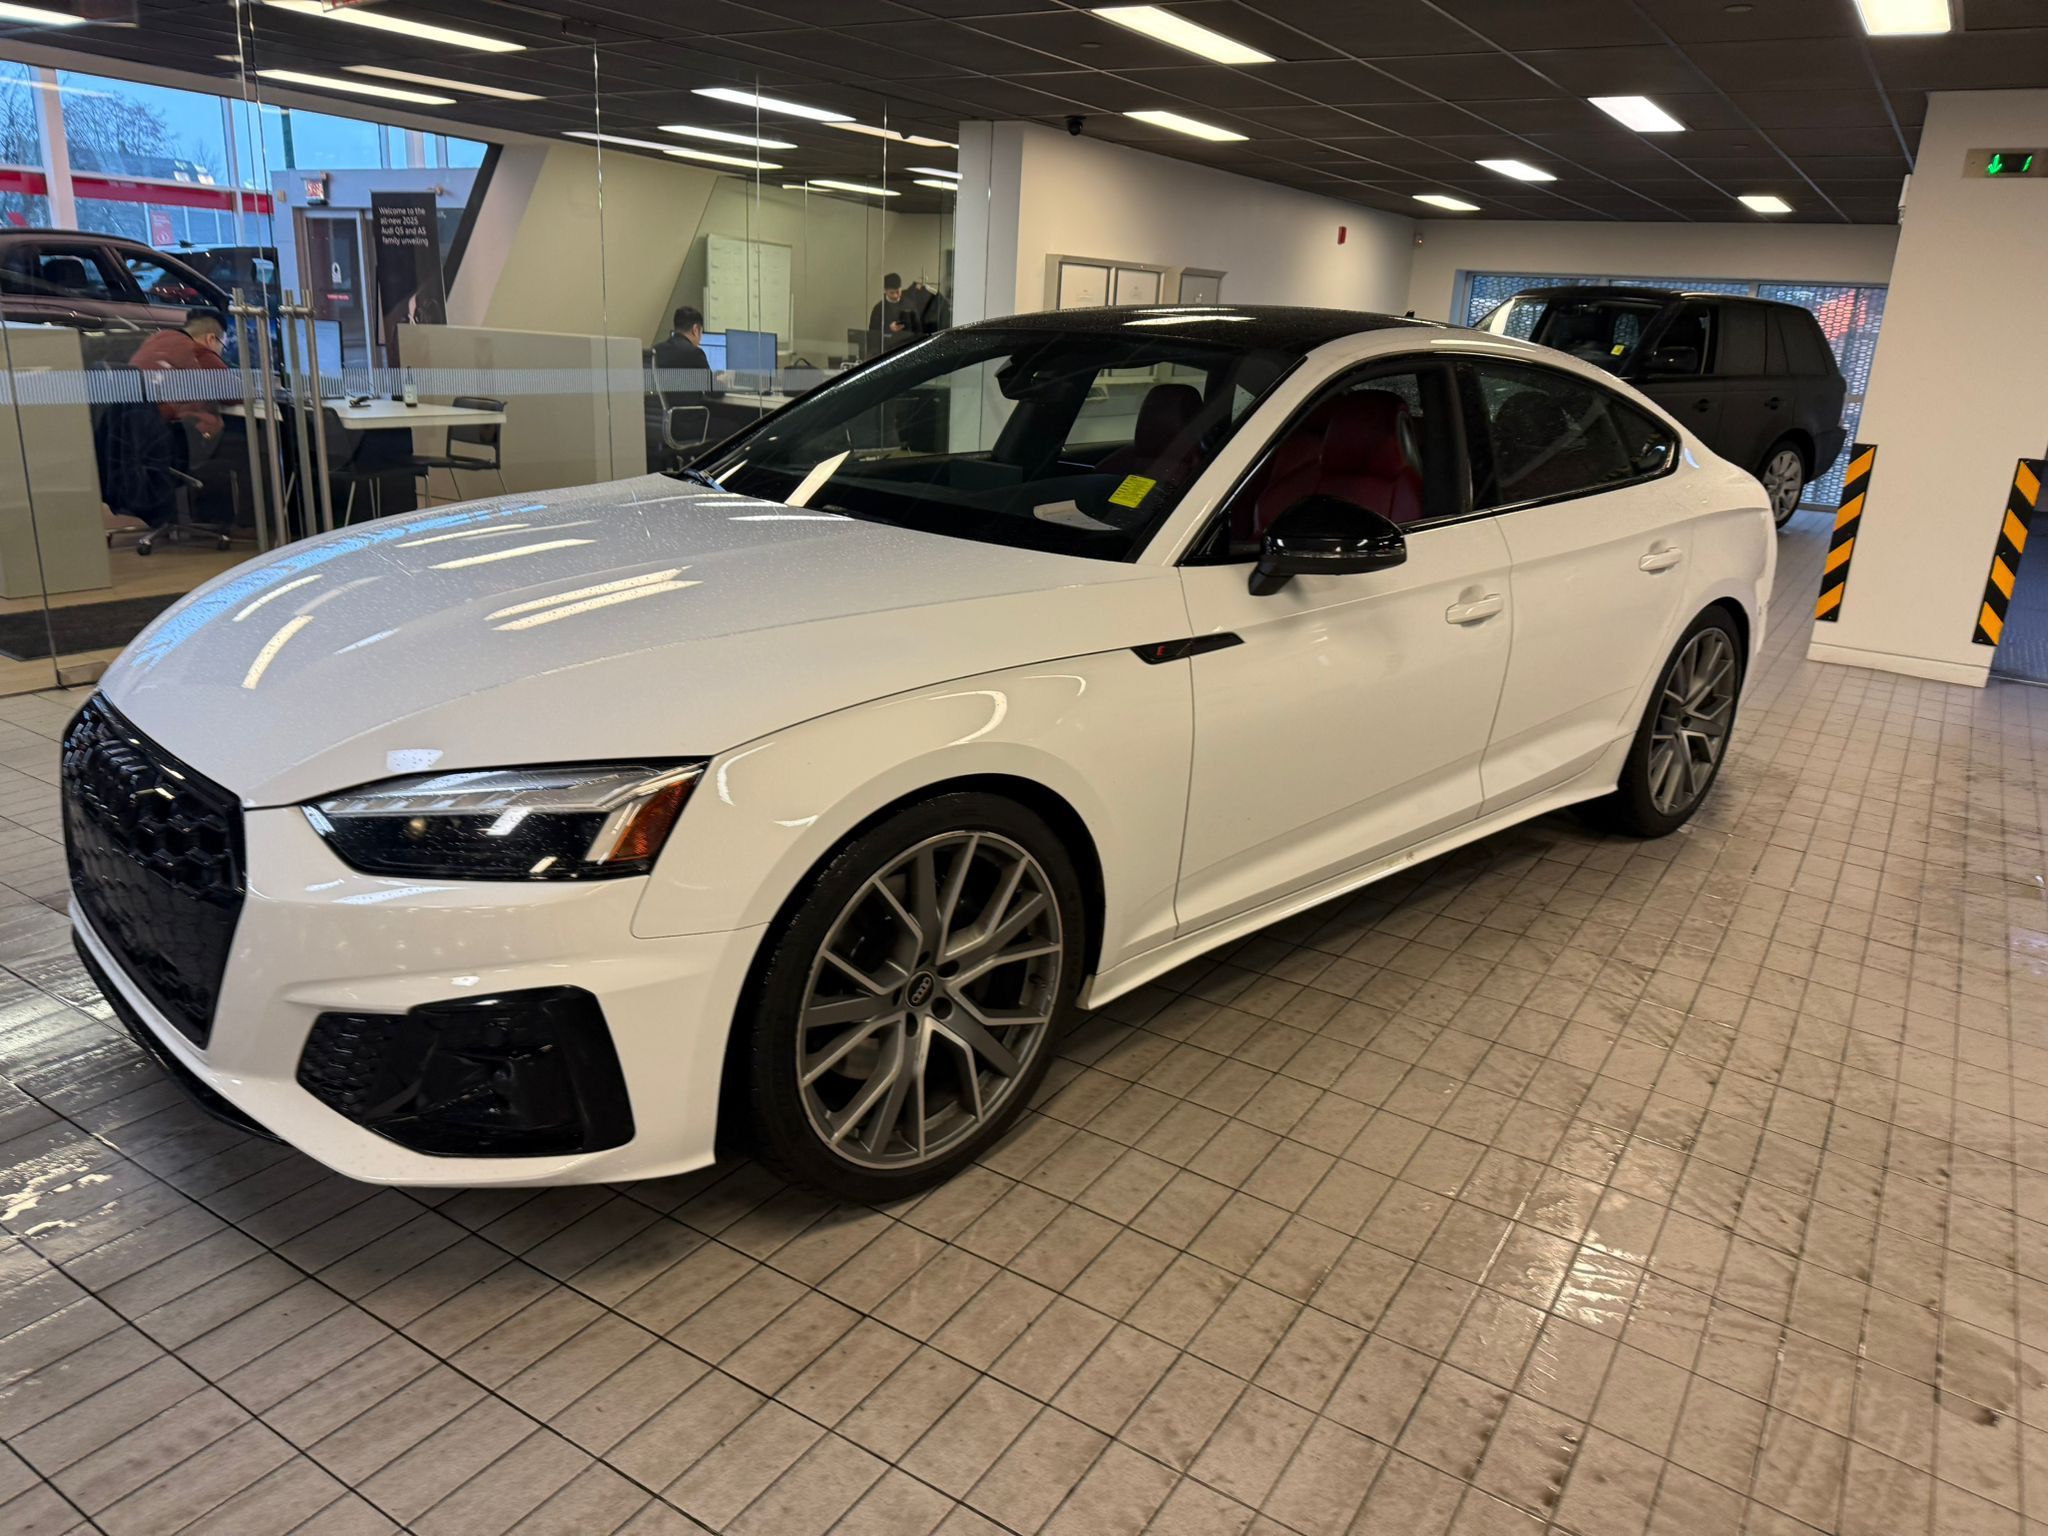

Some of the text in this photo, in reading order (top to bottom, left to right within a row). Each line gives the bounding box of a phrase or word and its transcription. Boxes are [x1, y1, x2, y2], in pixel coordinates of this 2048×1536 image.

[378, 207, 426, 216] Welcome to the
[402, 216, 419, 225] 2025
[381, 226, 394, 235] Audi
[394, 226, 404, 236] Q5
[405, 227, 417, 235] and
[382, 236, 429, 247] family unveiling
